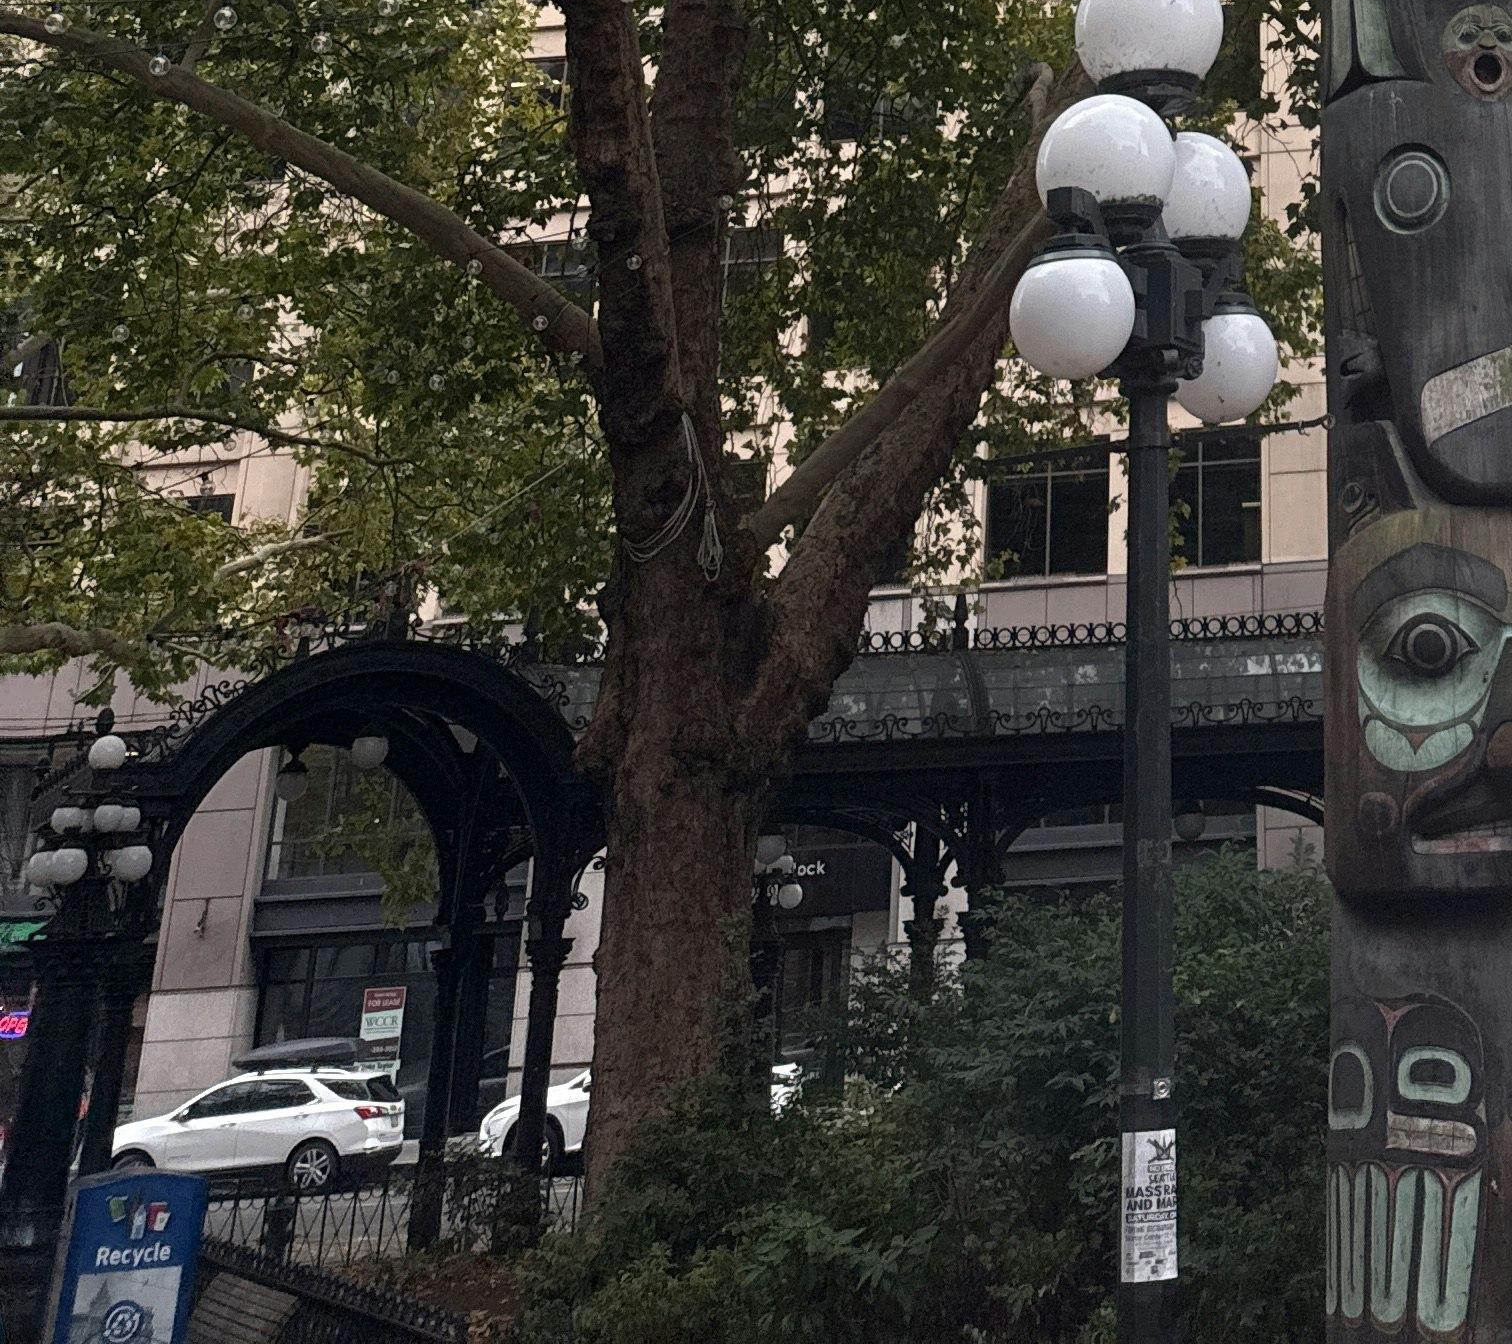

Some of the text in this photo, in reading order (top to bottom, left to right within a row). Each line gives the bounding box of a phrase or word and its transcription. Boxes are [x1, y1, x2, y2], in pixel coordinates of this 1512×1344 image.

[367, 997, 401, 1007] FOR LEASE
[1126, 1185, 1162, 1199] MASS
[1126, 1199, 1153, 1211] AND
[95, 1240, 172, 1267] Recycle
